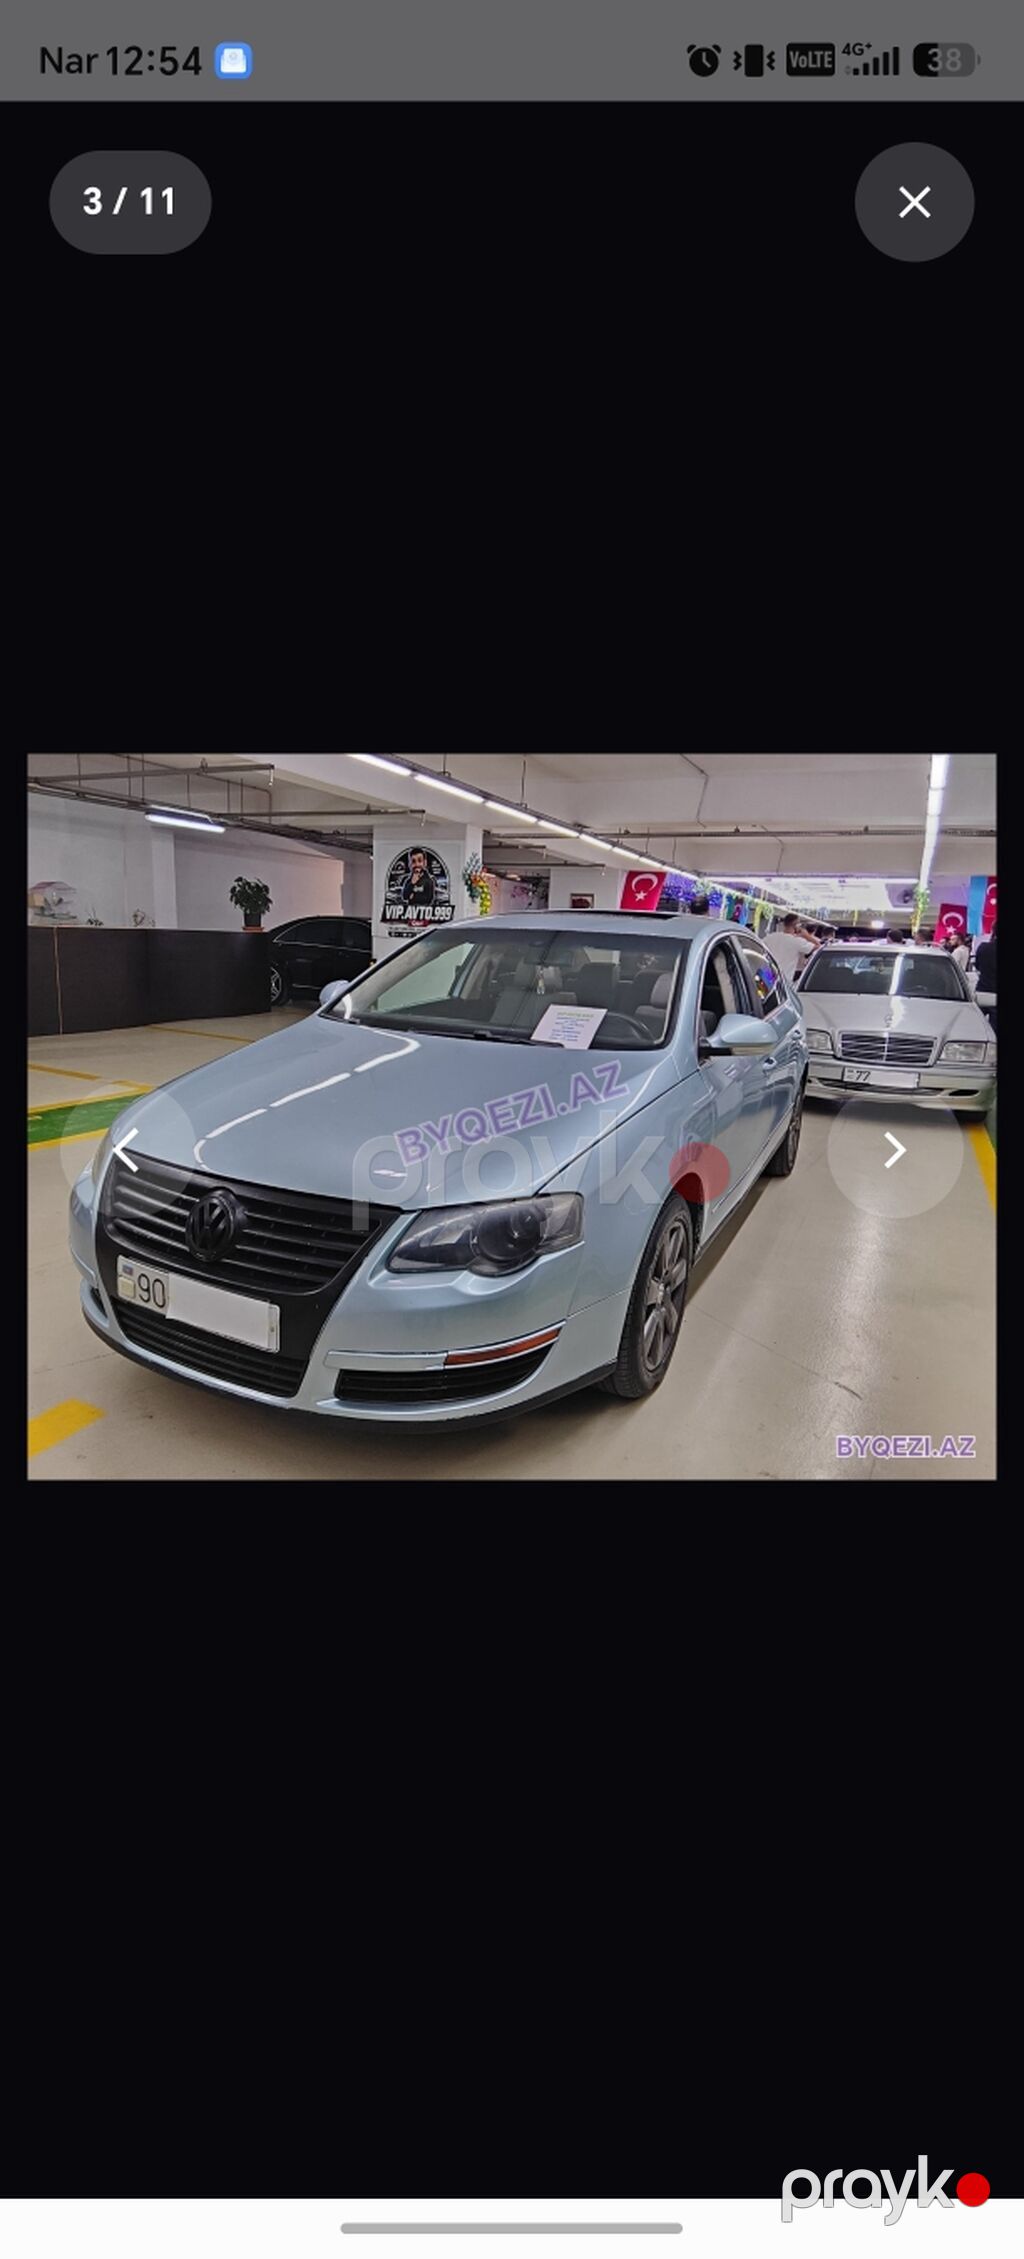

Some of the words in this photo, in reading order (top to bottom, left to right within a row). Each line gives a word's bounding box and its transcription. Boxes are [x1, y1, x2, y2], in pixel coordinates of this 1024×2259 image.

[40, 46, 99, 74] Nar
[106, 45, 202, 76] 12:54
[790, 51, 833, 68] VoLTE
[928, 49, 962, 72] 38
[83, 186, 102, 215] 3
[140, 187, 173, 215] 11
[856, 1070, 871, 1081] 77
[137, 1273, 166, 1308] 90
